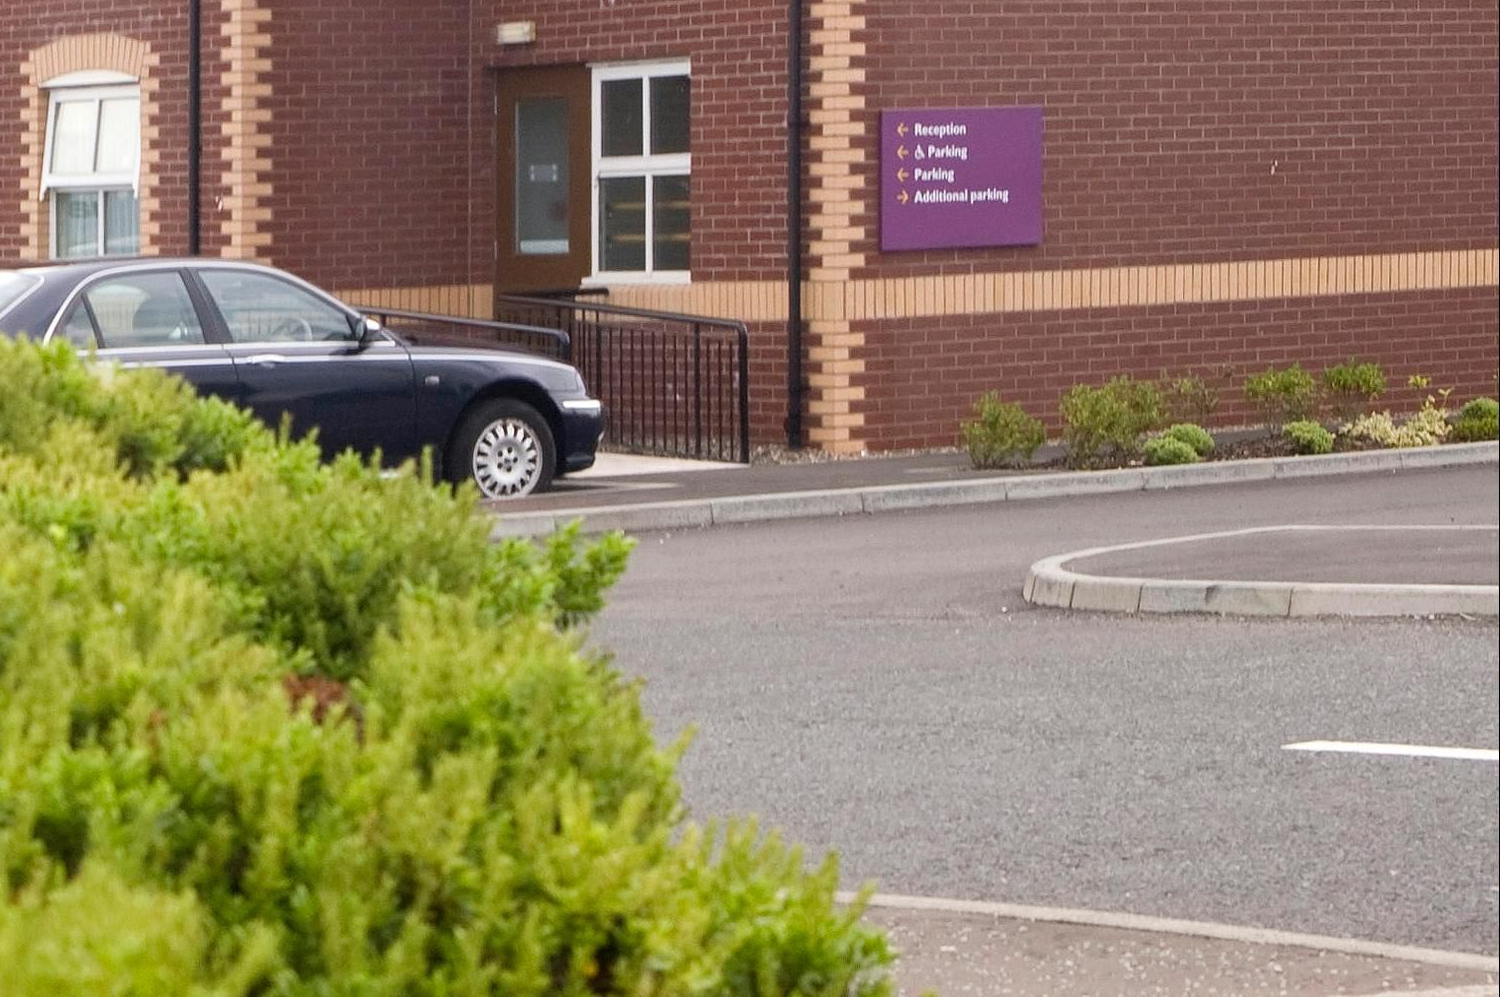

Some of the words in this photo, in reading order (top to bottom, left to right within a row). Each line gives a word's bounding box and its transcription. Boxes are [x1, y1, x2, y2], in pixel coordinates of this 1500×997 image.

[914, 122, 967, 138] Reception
[928, 145, 968, 160] Parking
[914, 167, 955, 183] Parking
[914, 189, 968, 203] Additional
[970, 187, 1009, 205] parking
